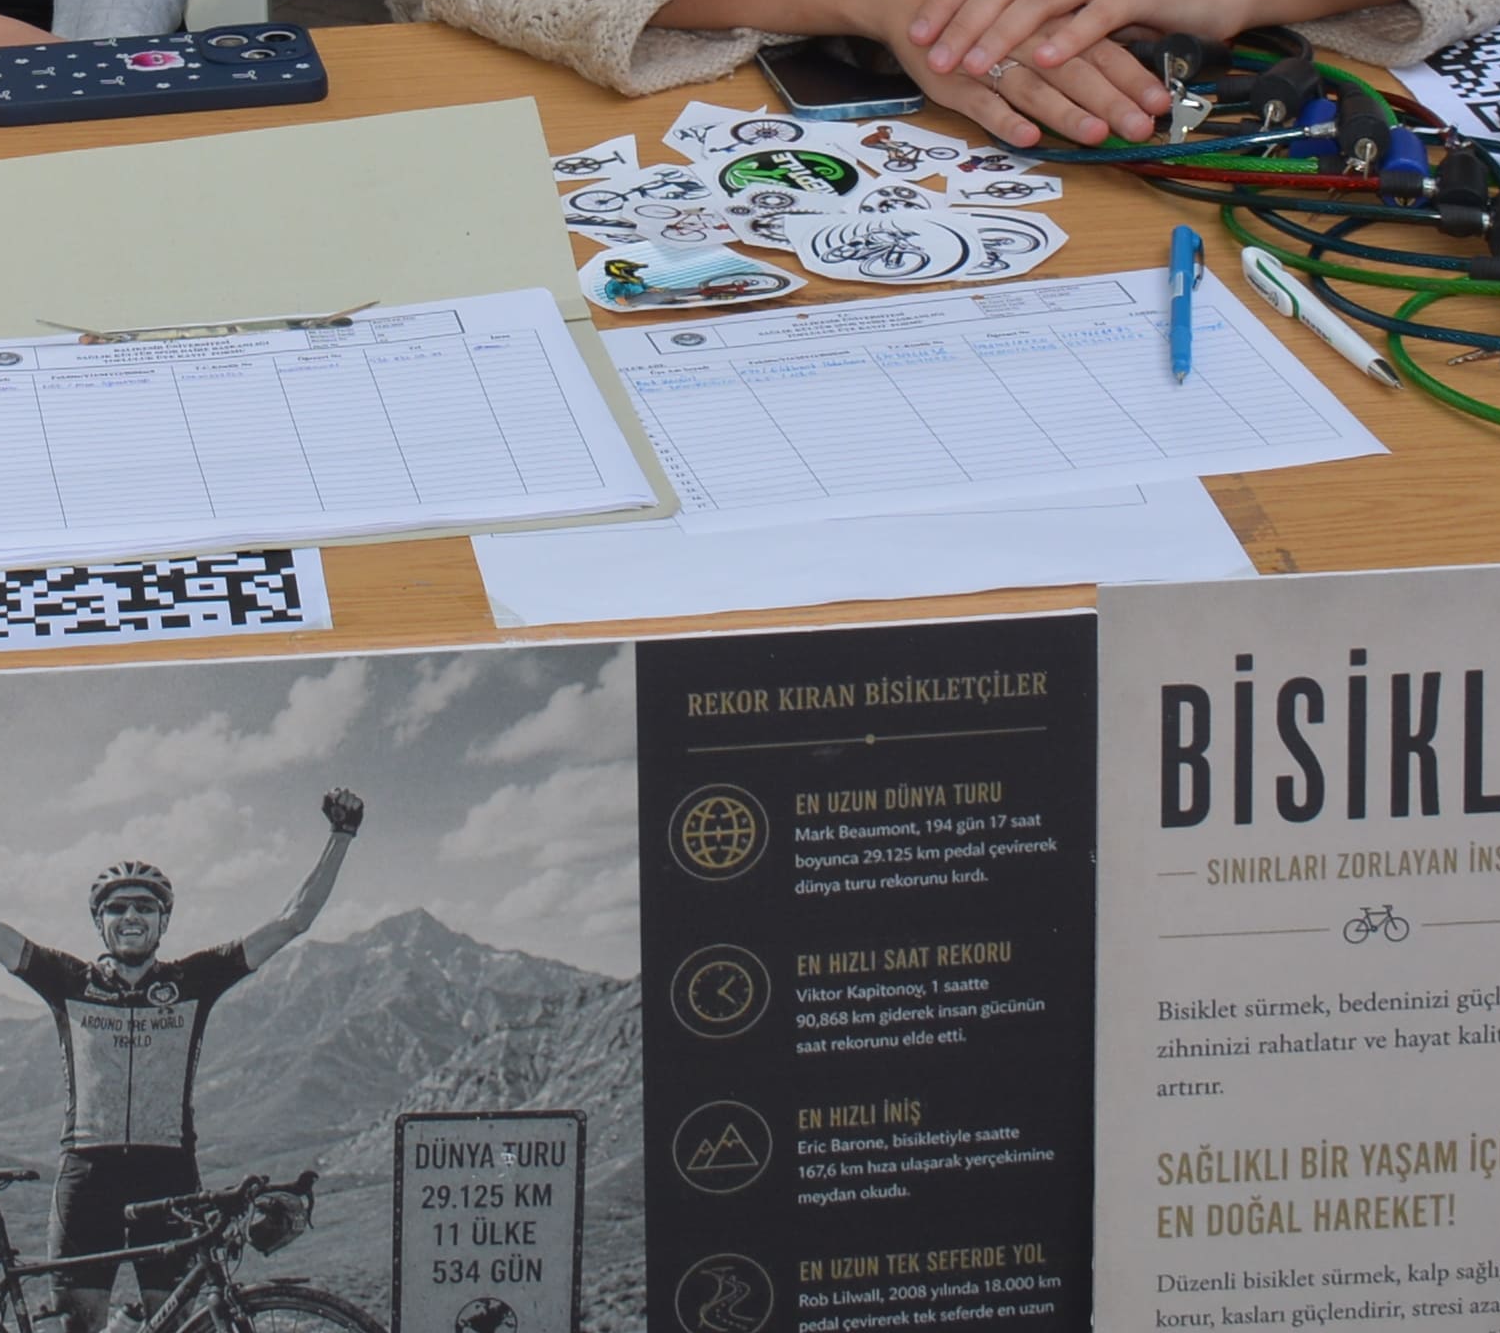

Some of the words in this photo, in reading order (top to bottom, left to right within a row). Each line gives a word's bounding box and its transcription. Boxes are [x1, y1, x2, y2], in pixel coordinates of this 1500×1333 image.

[687, 691, 769, 717] REKOR
[779, 684, 855, 711] KIRAN
[865, 670, 1047, 705] BİSİKLETÇİLER
[796, 794, 820, 815] EN
[828, 790, 877, 813] UZUN
[885, 784, 946, 810] DÜNYA
[953, 781, 1001, 804] TURU
[795, 826, 835, 842] Mark
[839, 821, 920, 840] Beaumont,
[926, 819, 953, 834] 194
[956, 818, 985, 834] gün
[990, 815, 1007, 829] 17
[1011, 814, 1041, 828] saat
[795, 852, 858, 870] boyunca
[863, 847, 912, 864] 29.125
[917, 845, 940, 860] km
[944, 842, 985, 861] pedal
[989, 838, 1057, 856] çevirerek
[1207, 855, 1327, 886] SINIRLARI
[1337, 848, 1458, 880] ZORLAYAN
[795, 878, 840, 896] dünya
[845, 878, 875, 891] turu
[880, 871, 947, 888] rekorunu
[952, 869, 988, 884] kırdı.
[798, 954, 821, 976] EN
[830, 951, 876, 974] HIZLI
[884, 947, 929, 971] SAAT
[937, 942, 1011, 966] REKORU
[1158, 999, 1237, 1022] Bisiklet
[1245, 997, 1331, 1019] sürmek,
[1339, 990, 1449, 1014] bedeninizi
[1156, 1038, 1250, 1060] zihninizi
[1258, 1032, 1355, 1055] rahatlatır
[1365, 1034, 1386, 1050] ve
[1394, 1029, 1451, 1053] hayat
[1156, 1079, 1224, 1098] artırır.
[800, 1108, 821, 1129] EN
[830, 1105, 876, 1128] HIZLI
[884, 1099, 920, 1126] İNİŞ
[415, 1141, 494, 1170] DÜNYA
[503, 1141, 567, 1168] TURU
[1157, 1145, 1288, 1186] SAĞLIKLI
[1300, 1139, 1348, 1180] BİR
[1360, 1141, 1458, 1183] YAŞAM
[421, 1185, 503, 1209] 29.125
[516, 1184, 552, 1207] KM
[1157, 1205, 1194, 1239] EN
[1207, 1198, 1301, 1237] DOĞAL
[1314, 1193, 1456, 1232] HAREKET!
[434, 1224, 460, 1246] 11
[471, 1218, 537, 1246] ÜLKE
[433, 1260, 479, 1284] 534
[491, 1256, 542, 1283] GÜN
[800, 1260, 822, 1281] EN
[831, 1256, 879, 1278] UZUN
[887, 1253, 920, 1274] TEK
[927, 1247, 1006, 1271] SEFERDE
[1014, 1243, 1045, 1264] YOL
[800, 1293, 828, 1307] Rob
[833, 1289, 884, 1307] Lilwall,
[889, 1286, 926, 1302] 2008
[930, 1281, 979, 1299] yılında
[984, 1277, 1034, 1293] 18.000
[1039, 1274, 1060, 1288] km
[1157, 1272, 1236, 1294] Düzenli
[1243, 1269, 1315, 1290] bisiklet
[1322, 1265, 1400, 1287] sürmek,
[1408, 1263, 1449, 1284] kalp
[1156, 1309, 1214, 1327] korur,
[1222, 1307, 1285, 1325] kasları
[1292, 1301, 1407, 1326] güçlendirir,
[1412, 1297, 1463, 1316] stresi
